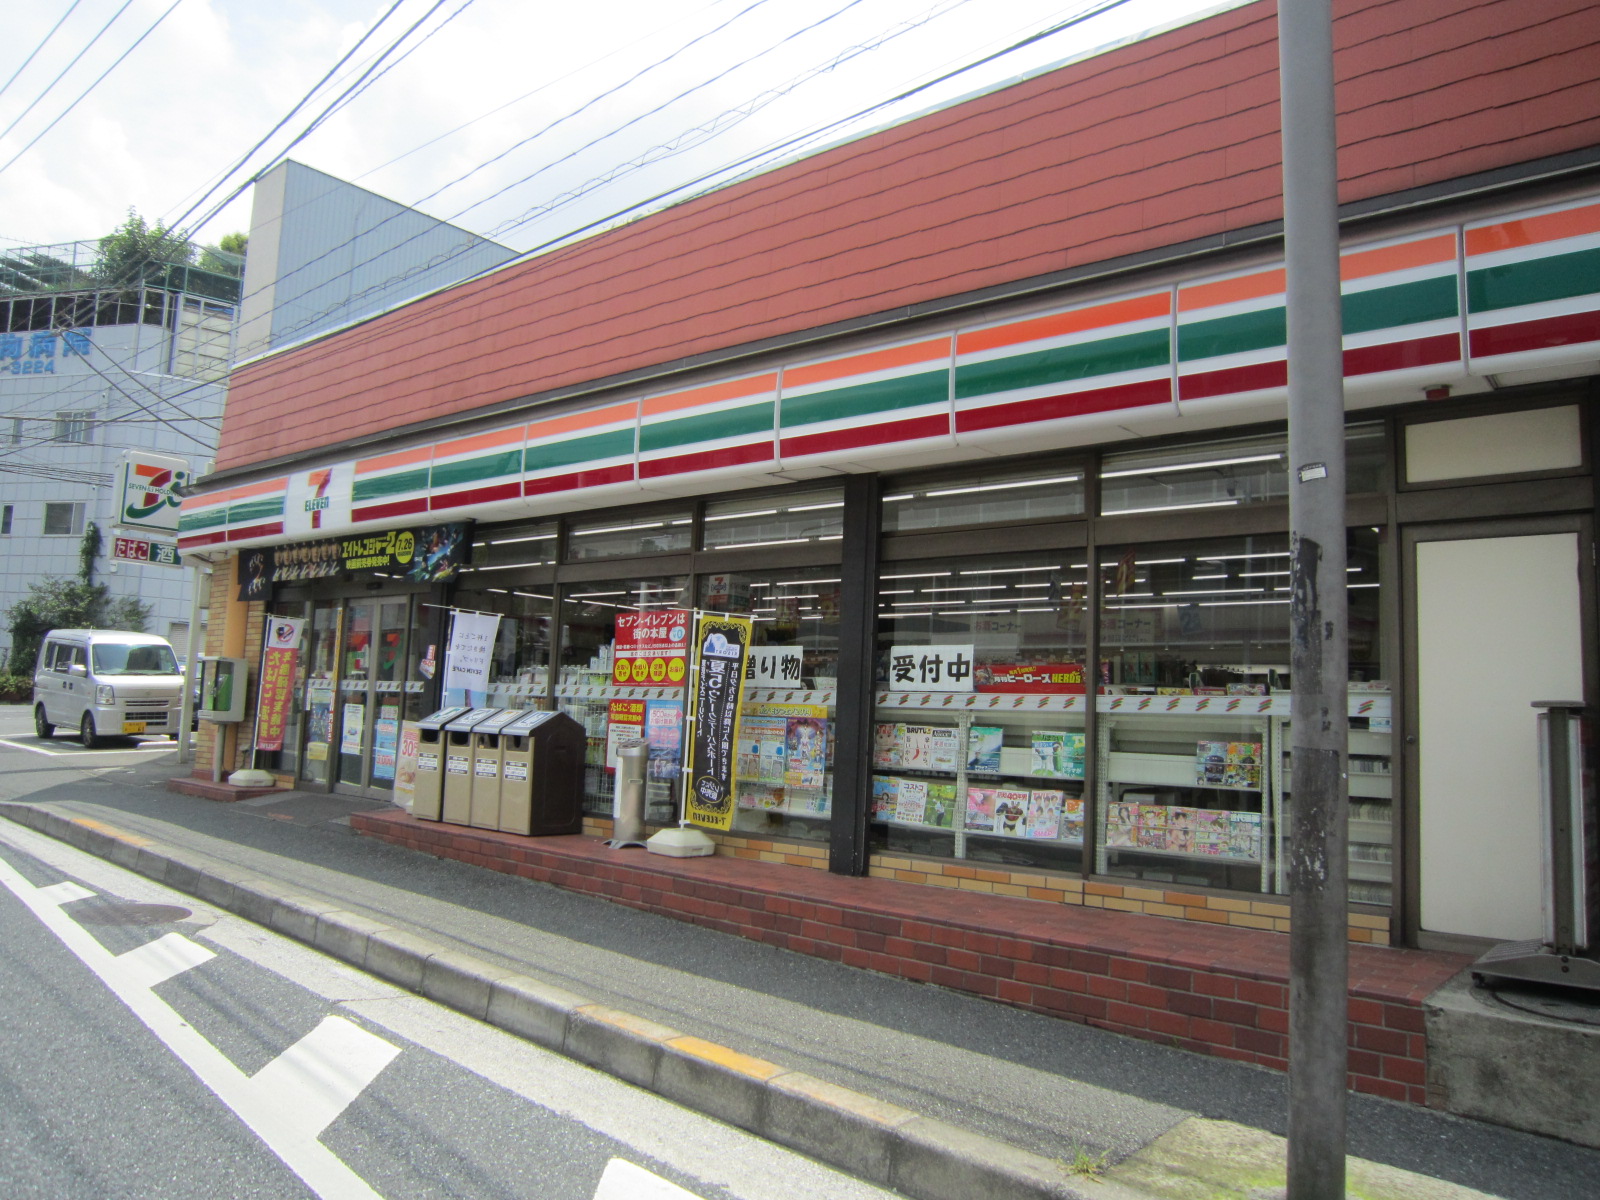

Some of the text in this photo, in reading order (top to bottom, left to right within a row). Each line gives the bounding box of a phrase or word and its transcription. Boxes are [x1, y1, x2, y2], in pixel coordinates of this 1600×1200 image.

[116, 539, 176, 563] たばこ 酒
[633, 627, 667, 640] 街の本屋
[891, 653, 971, 684] 受付中
[903, 782, 924, 791] コストコ
